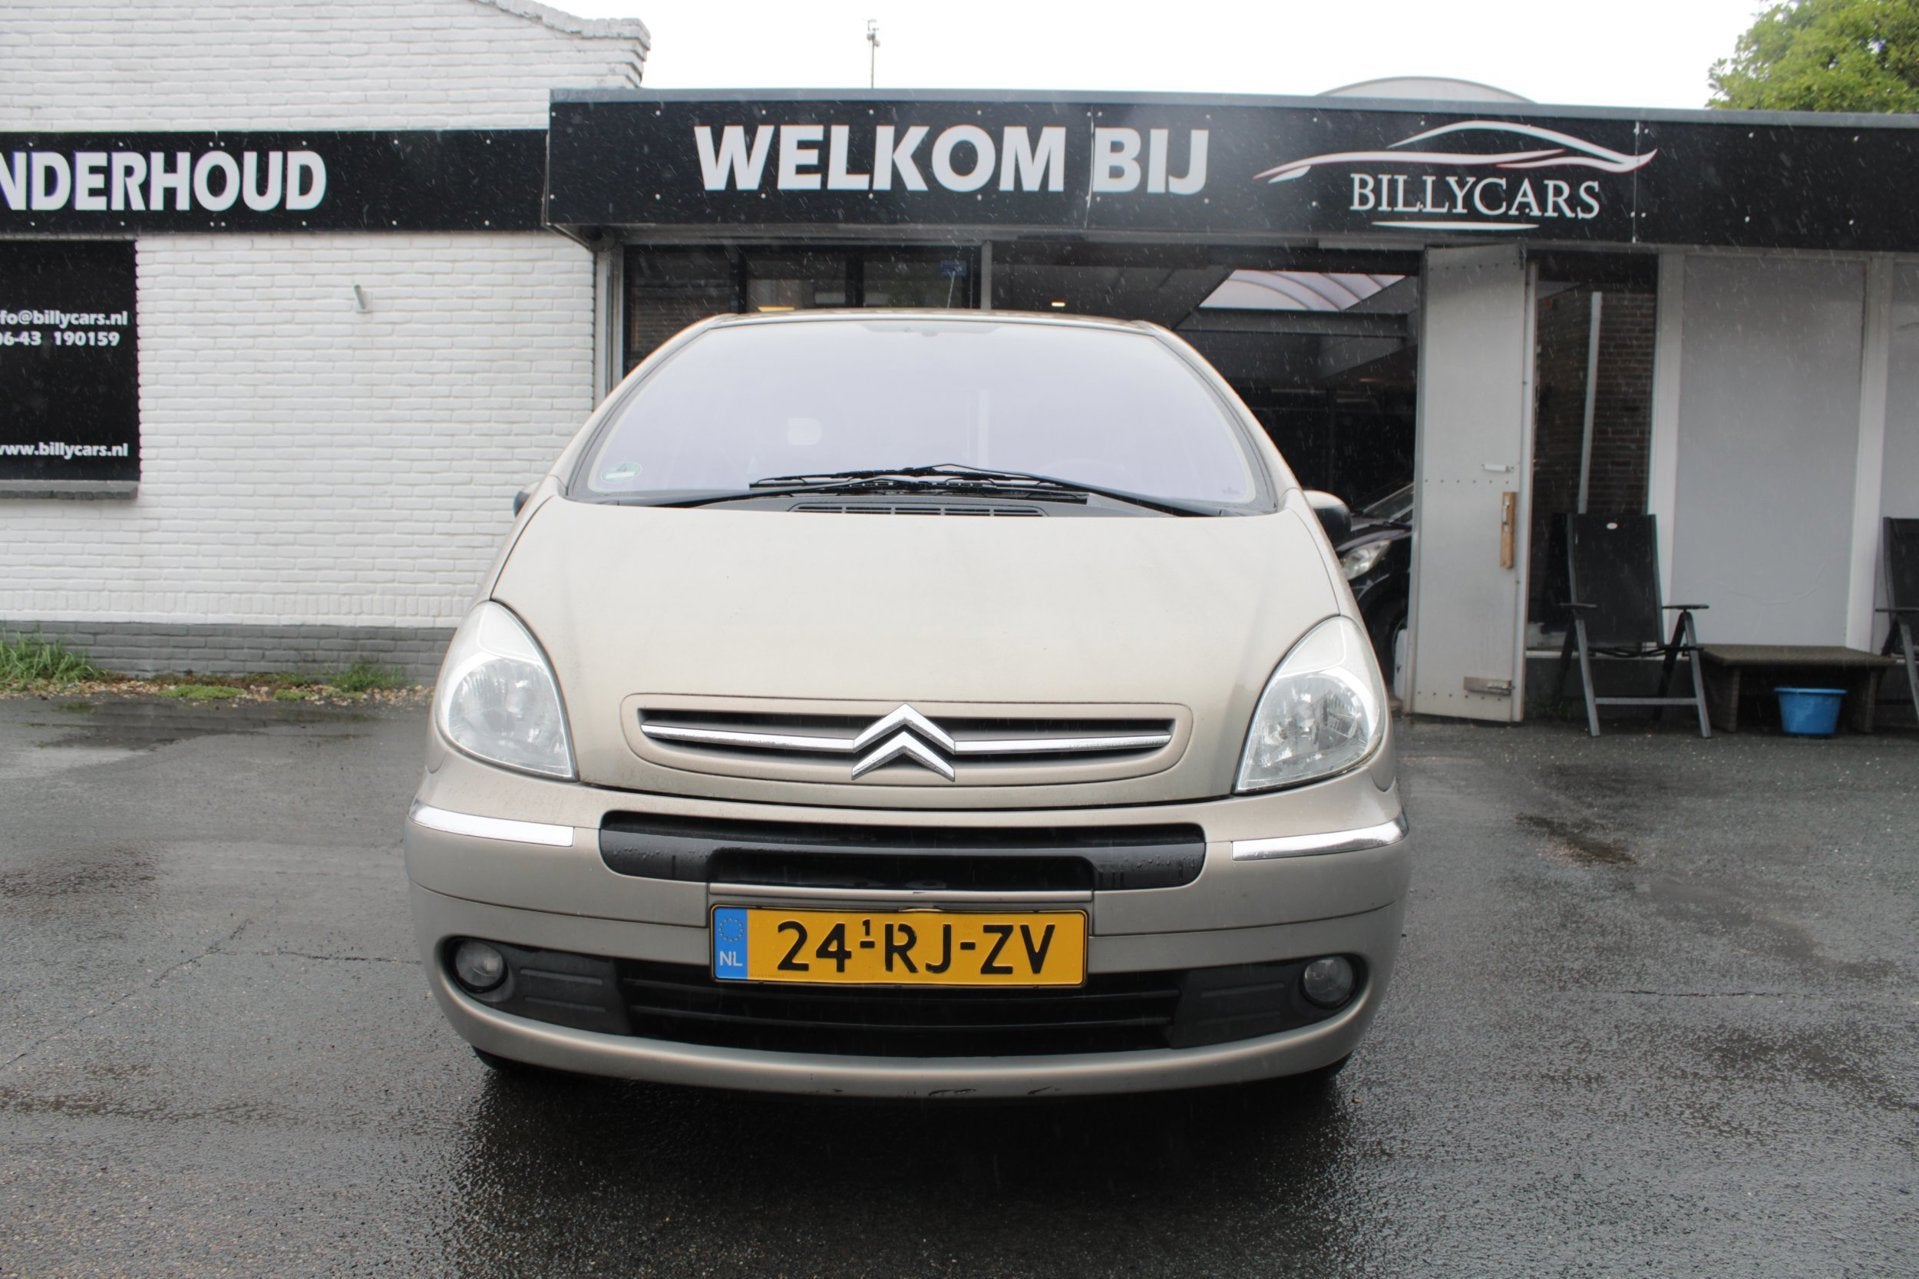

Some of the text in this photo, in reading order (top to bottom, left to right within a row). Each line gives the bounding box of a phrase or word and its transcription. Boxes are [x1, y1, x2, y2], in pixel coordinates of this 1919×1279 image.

[694, 124, 1210, 195] WELKOM BIJ
[1349, 173, 1600, 220] BILLYCARS
[53, 331, 120, 346] 190159
[719, 951, 743, 967] NL
